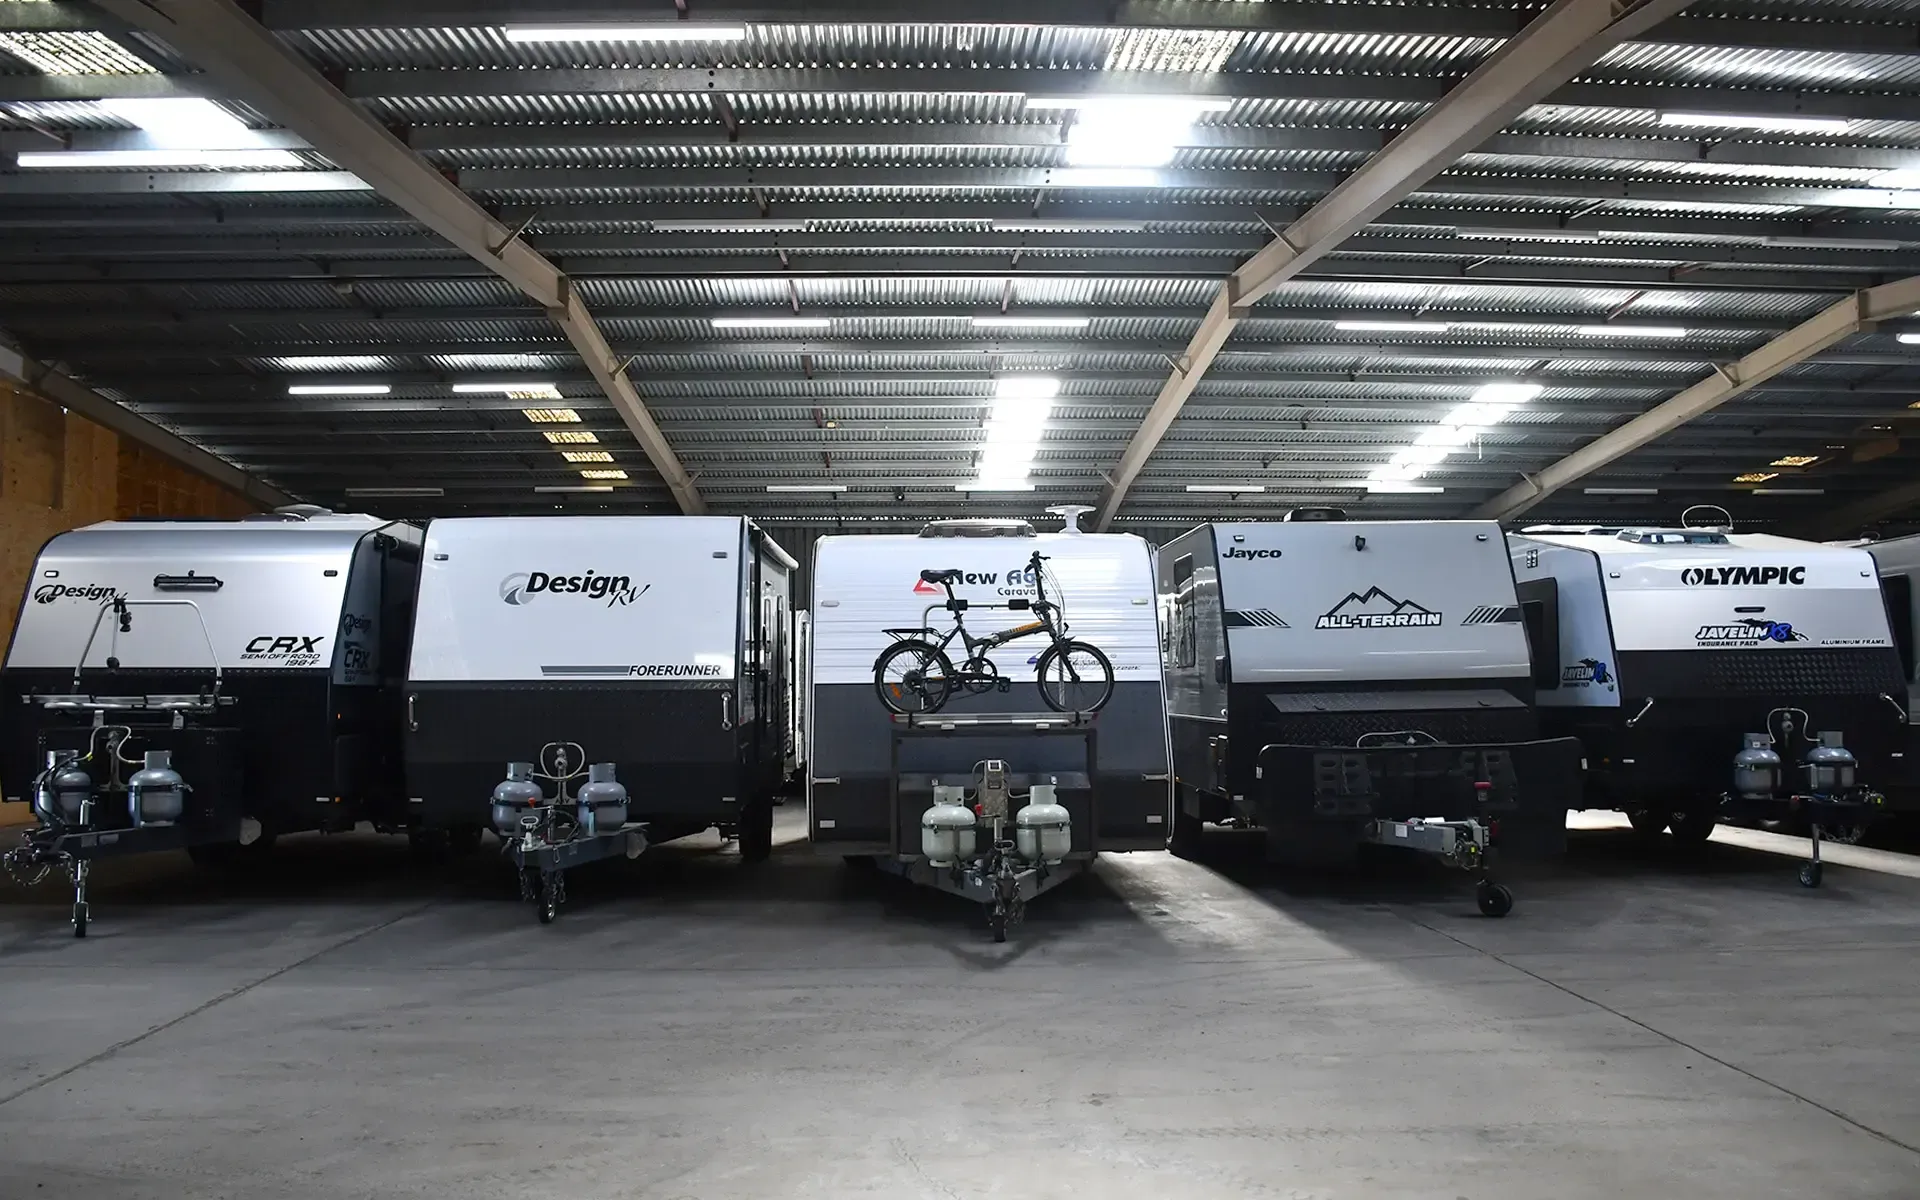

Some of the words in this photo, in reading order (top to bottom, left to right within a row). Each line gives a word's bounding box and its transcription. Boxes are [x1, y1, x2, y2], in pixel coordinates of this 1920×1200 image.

[1222, 547, 1282, 561] Jayco
[1006, 569, 1048, 588] Ag
[1681, 566, 1806, 586] OLYMPIC
[51, 583, 116, 601] Design
[526, 569, 630, 599] Design
[607, 584, 650, 608] RV
[997, 587, 1048, 596] Caravas
[1316, 613, 1442, 629] ALL-TERRAIN
[1695, 626, 1769, 640] JAVELIN
[245, 636, 325, 653] CRX
[629, 664, 721, 676] FORERUNNER
